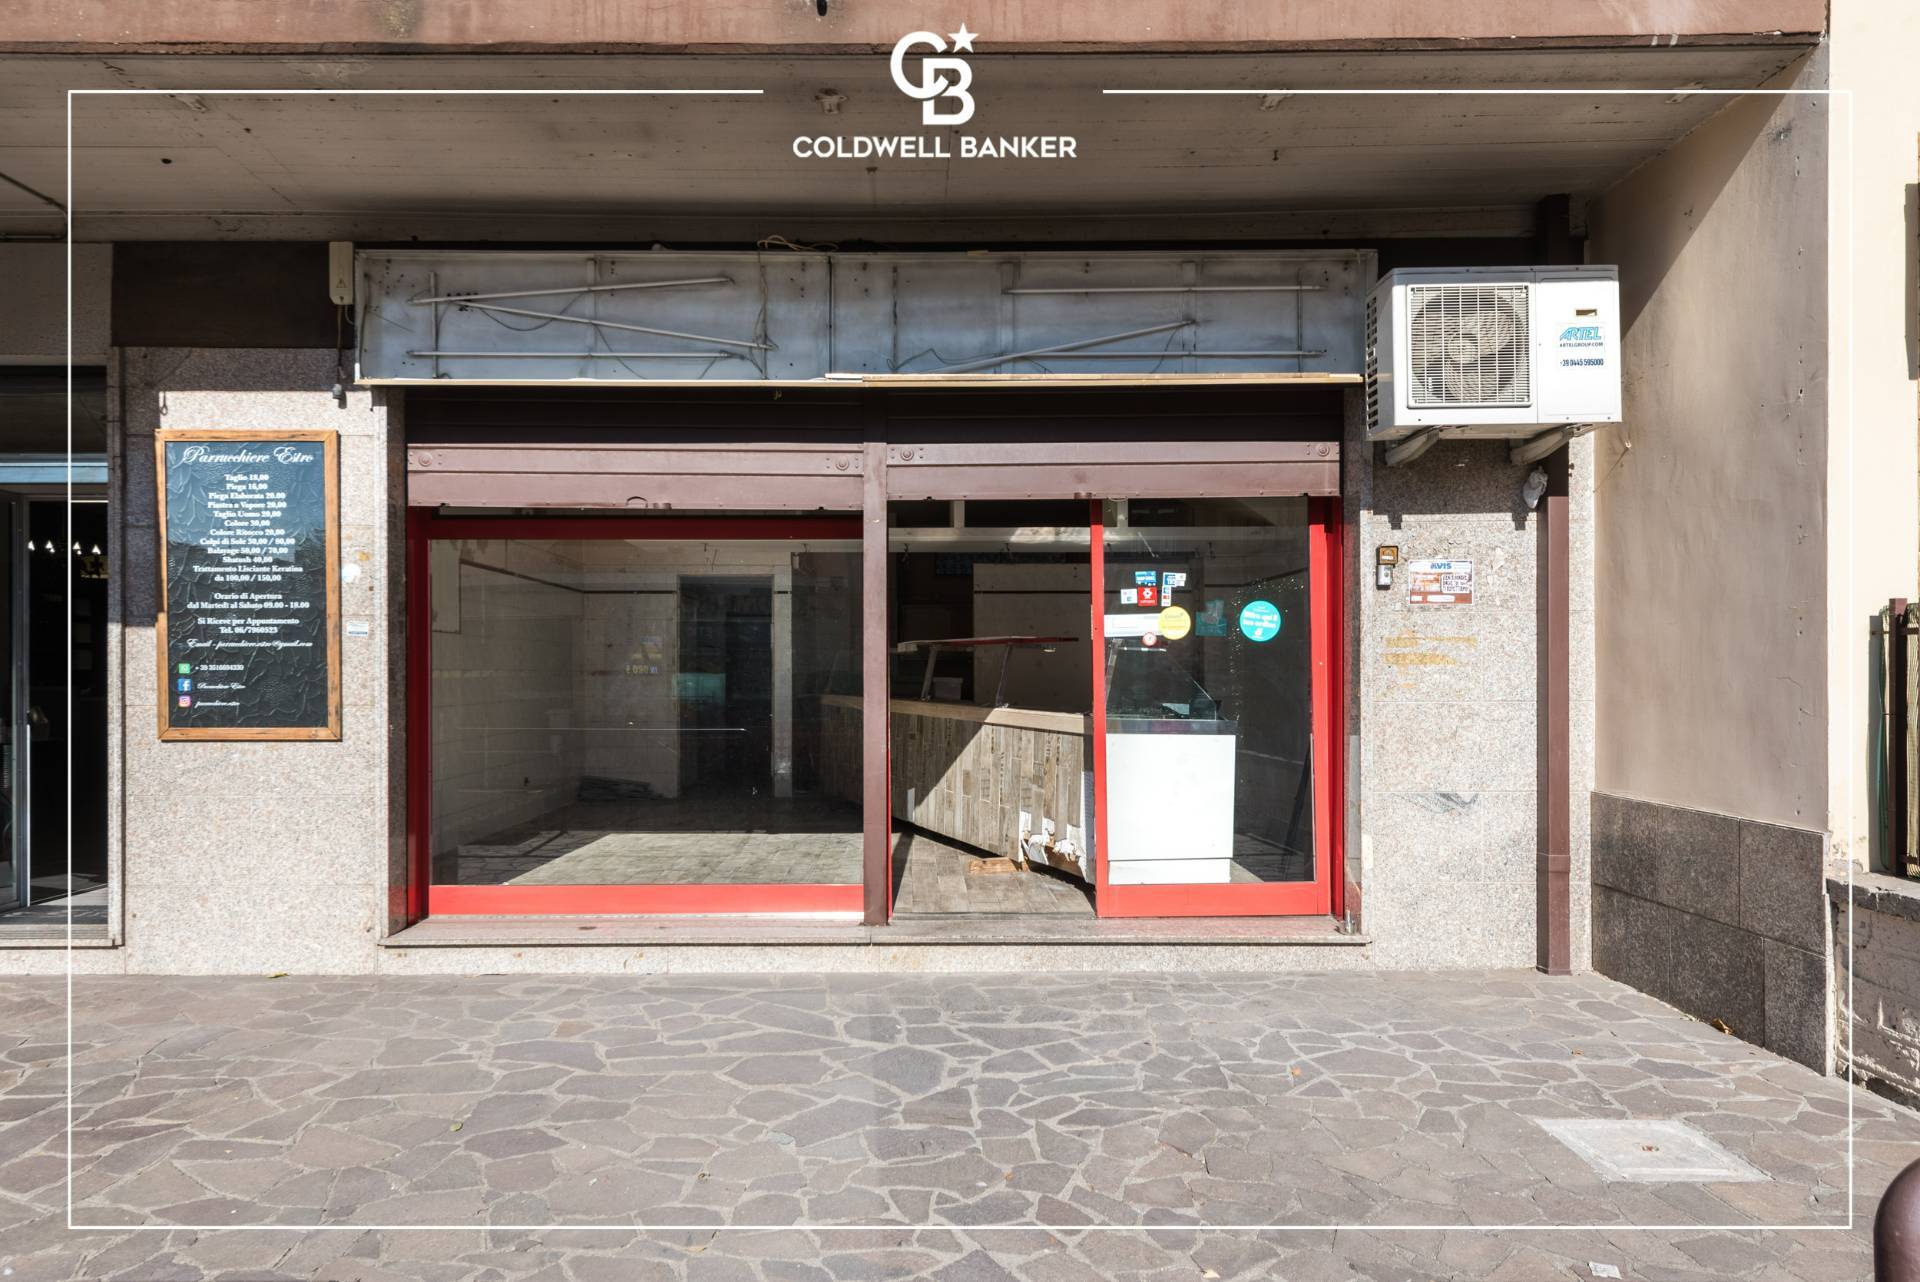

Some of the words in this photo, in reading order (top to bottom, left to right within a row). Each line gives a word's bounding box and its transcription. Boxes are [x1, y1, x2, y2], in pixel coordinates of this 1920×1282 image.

[1559, 326, 1602, 341] ARTEL
[182, 445, 270, 464] Parrucchiere
[274, 446, 314, 464] Estro
[224, 474, 248, 482] Taglio
[226, 483, 246, 492] Piega
[208, 492, 228, 501] Piega
[240, 502, 266, 510] Vapore
[200, 538, 220, 546] Colpi
[249, 593, 282, 601] Apertura
[187, 639, 212, 647] Email
